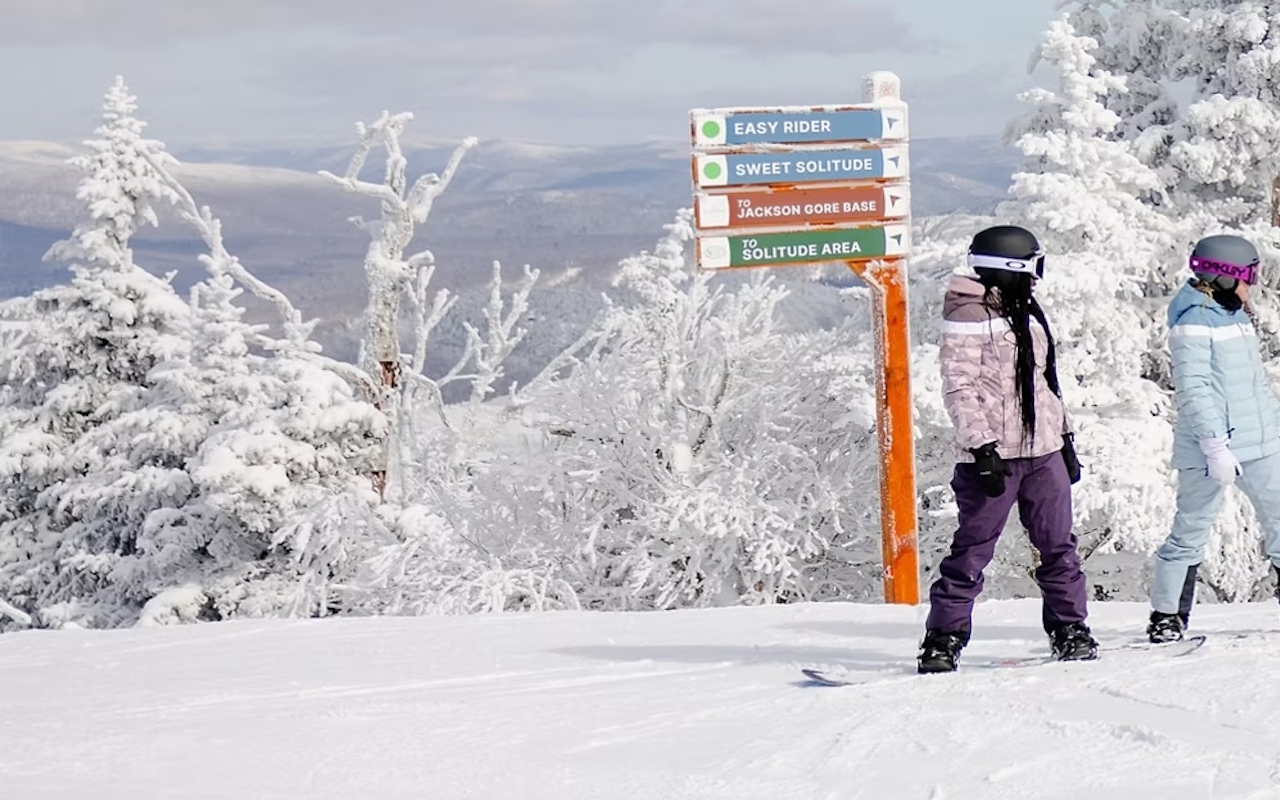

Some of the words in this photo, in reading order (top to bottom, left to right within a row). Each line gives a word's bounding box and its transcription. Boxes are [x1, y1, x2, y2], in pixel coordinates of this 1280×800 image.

[734, 121, 778, 135] EASY
[783, 120, 831, 134] RIDER
[735, 162, 791, 176] SWEET
[795, 158, 873, 173] SOLITUDE
[737, 199, 751, 208] TO
[737, 205, 801, 218] JACKSON
[804, 202, 840, 215] GORE
[842, 201, 877, 212] BASE
[742, 239, 758, 249] TO
[742, 244, 817, 260] SOLITUDE
[821, 241, 861, 255] AREA
[1202, 261, 1247, 276] OAKLEY
